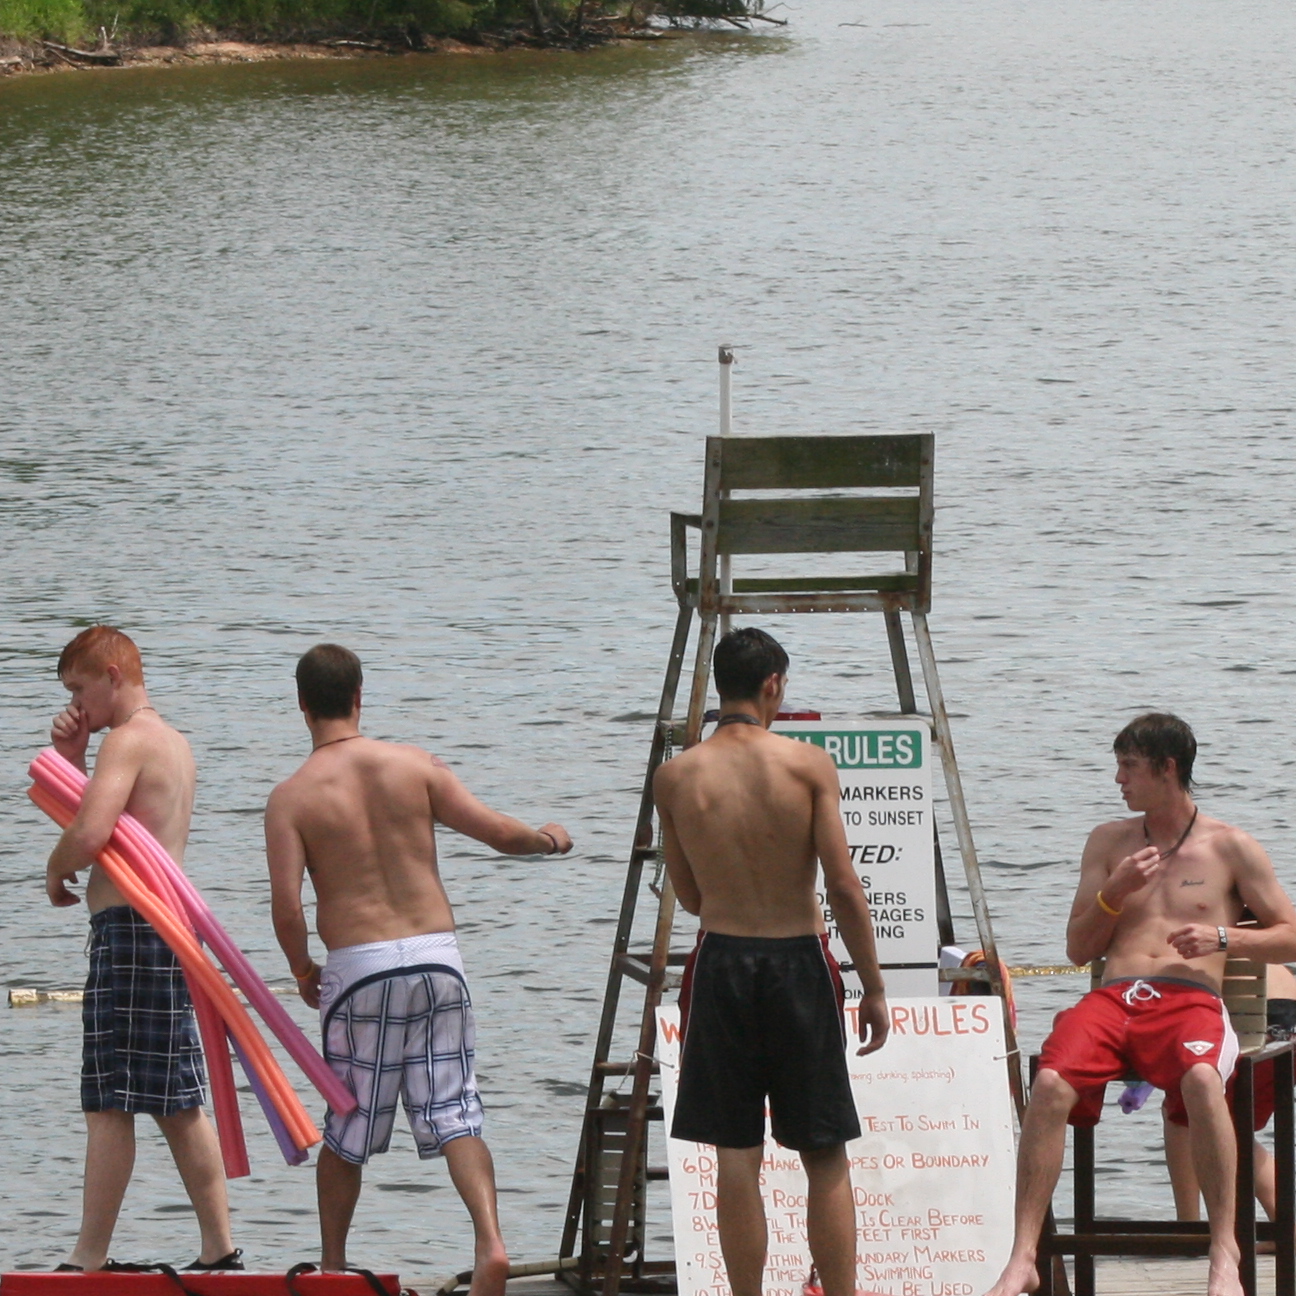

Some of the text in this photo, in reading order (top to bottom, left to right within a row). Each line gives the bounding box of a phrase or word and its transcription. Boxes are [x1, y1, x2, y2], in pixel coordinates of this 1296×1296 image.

[825, 735, 913, 765] RULES
[840, 786, 923, 800] MARKERS
[845, 811, 924, 825] TO SUNSET
[848, 845, 903, 864] TED:
[891, 1004, 989, 1036] RULES
[863, 1114, 979, 1132] TEST TO SWIM IN
[762, 1153, 800, 1171] HANG
[883, 1153, 905, 1170] OR
[911, 1153, 989, 1169] BOUNDARY
[854, 1187, 894, 1206] DOCK
[879, 1209, 922, 1227] CLEAR
[928, 1208, 984, 1227] BEFORE
[771, 1230, 797, 1243] THE
[901, 1228, 940, 1241] FIRST
[769, 1254, 803, 1267] ITHIN
[914, 1246, 985, 1263] MARKERS
[765, 1268, 808, 1282] TIMES
[864, 1265, 932, 1281] SWIMMING
[902, 1281, 925, 1296] BE
[930, 1281, 974, 1296] USED
